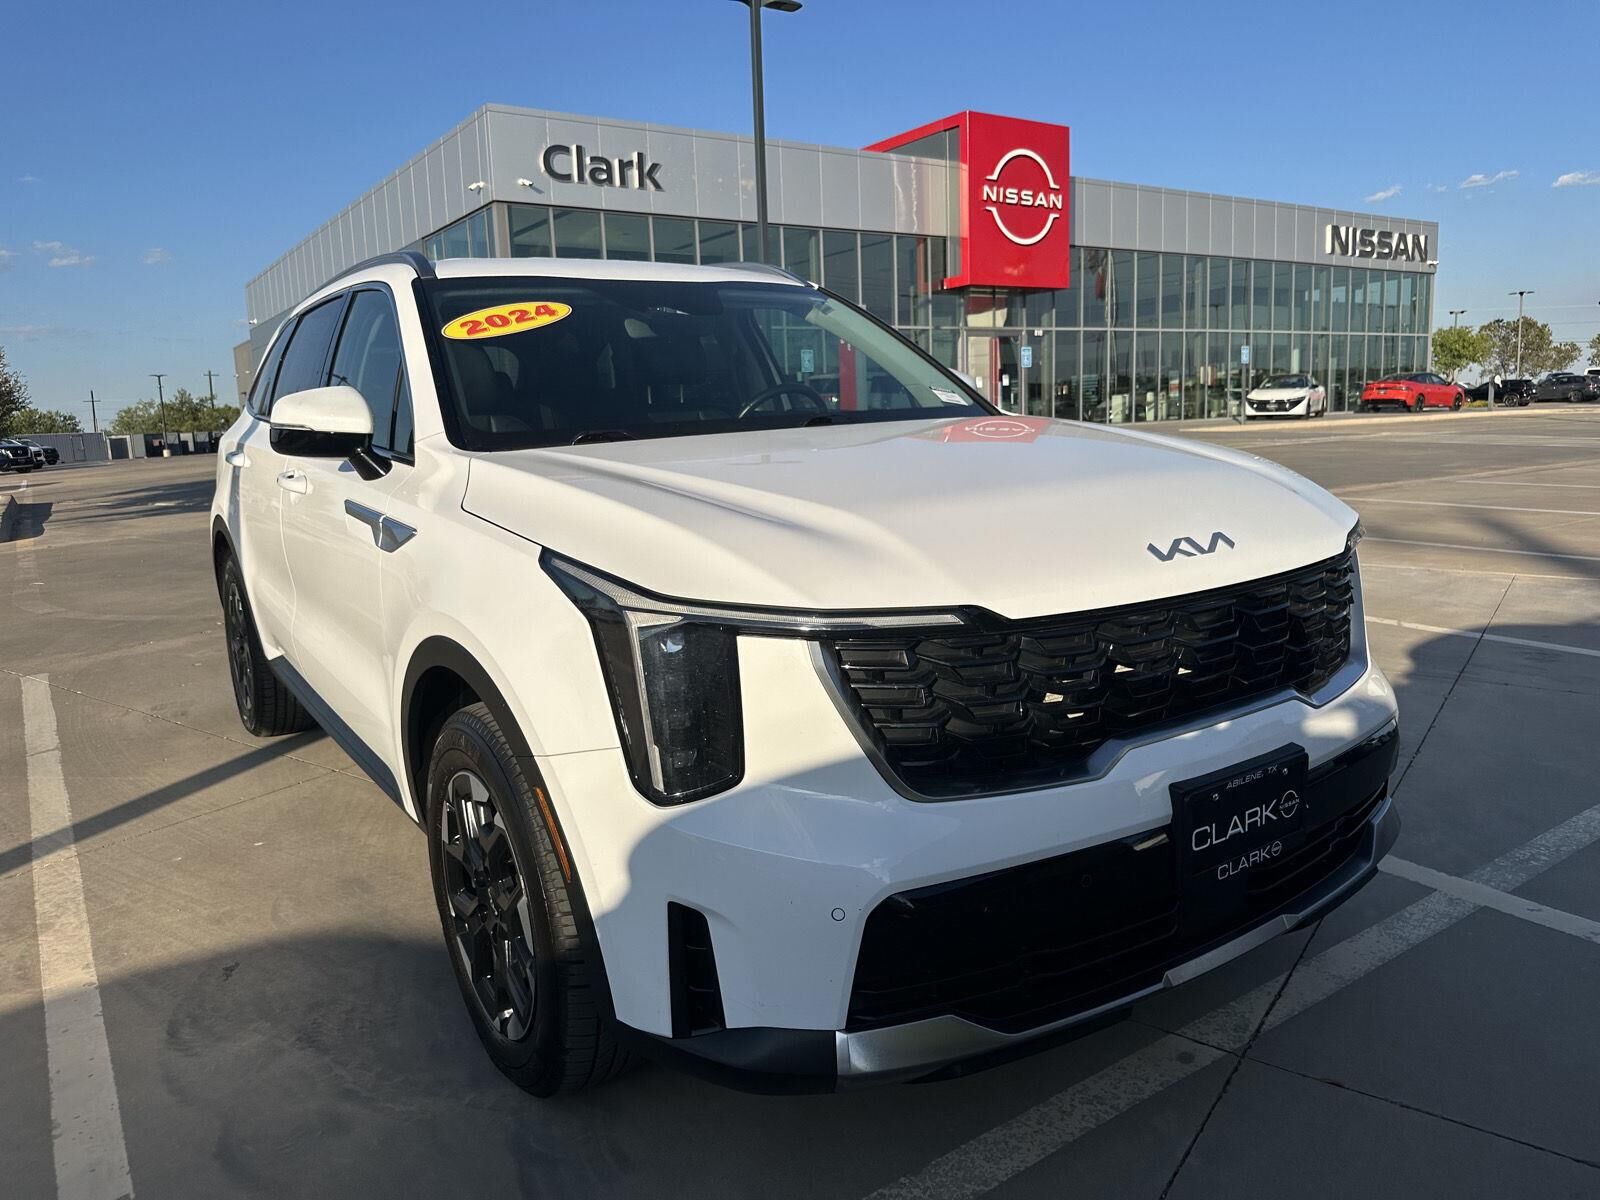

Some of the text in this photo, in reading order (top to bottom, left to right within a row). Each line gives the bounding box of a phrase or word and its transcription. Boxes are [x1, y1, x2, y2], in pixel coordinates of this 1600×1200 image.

[540, 144, 665, 192] Clark
[983, 184, 1063, 210] NISSAN
[1325, 224, 1429, 263] NISSAN
[459, 304, 559, 336] 2024
[1267, 764, 1278, 774] TX
[1191, 799, 1277, 852] CLARK
[1217, 845, 1271, 880] CLARK
